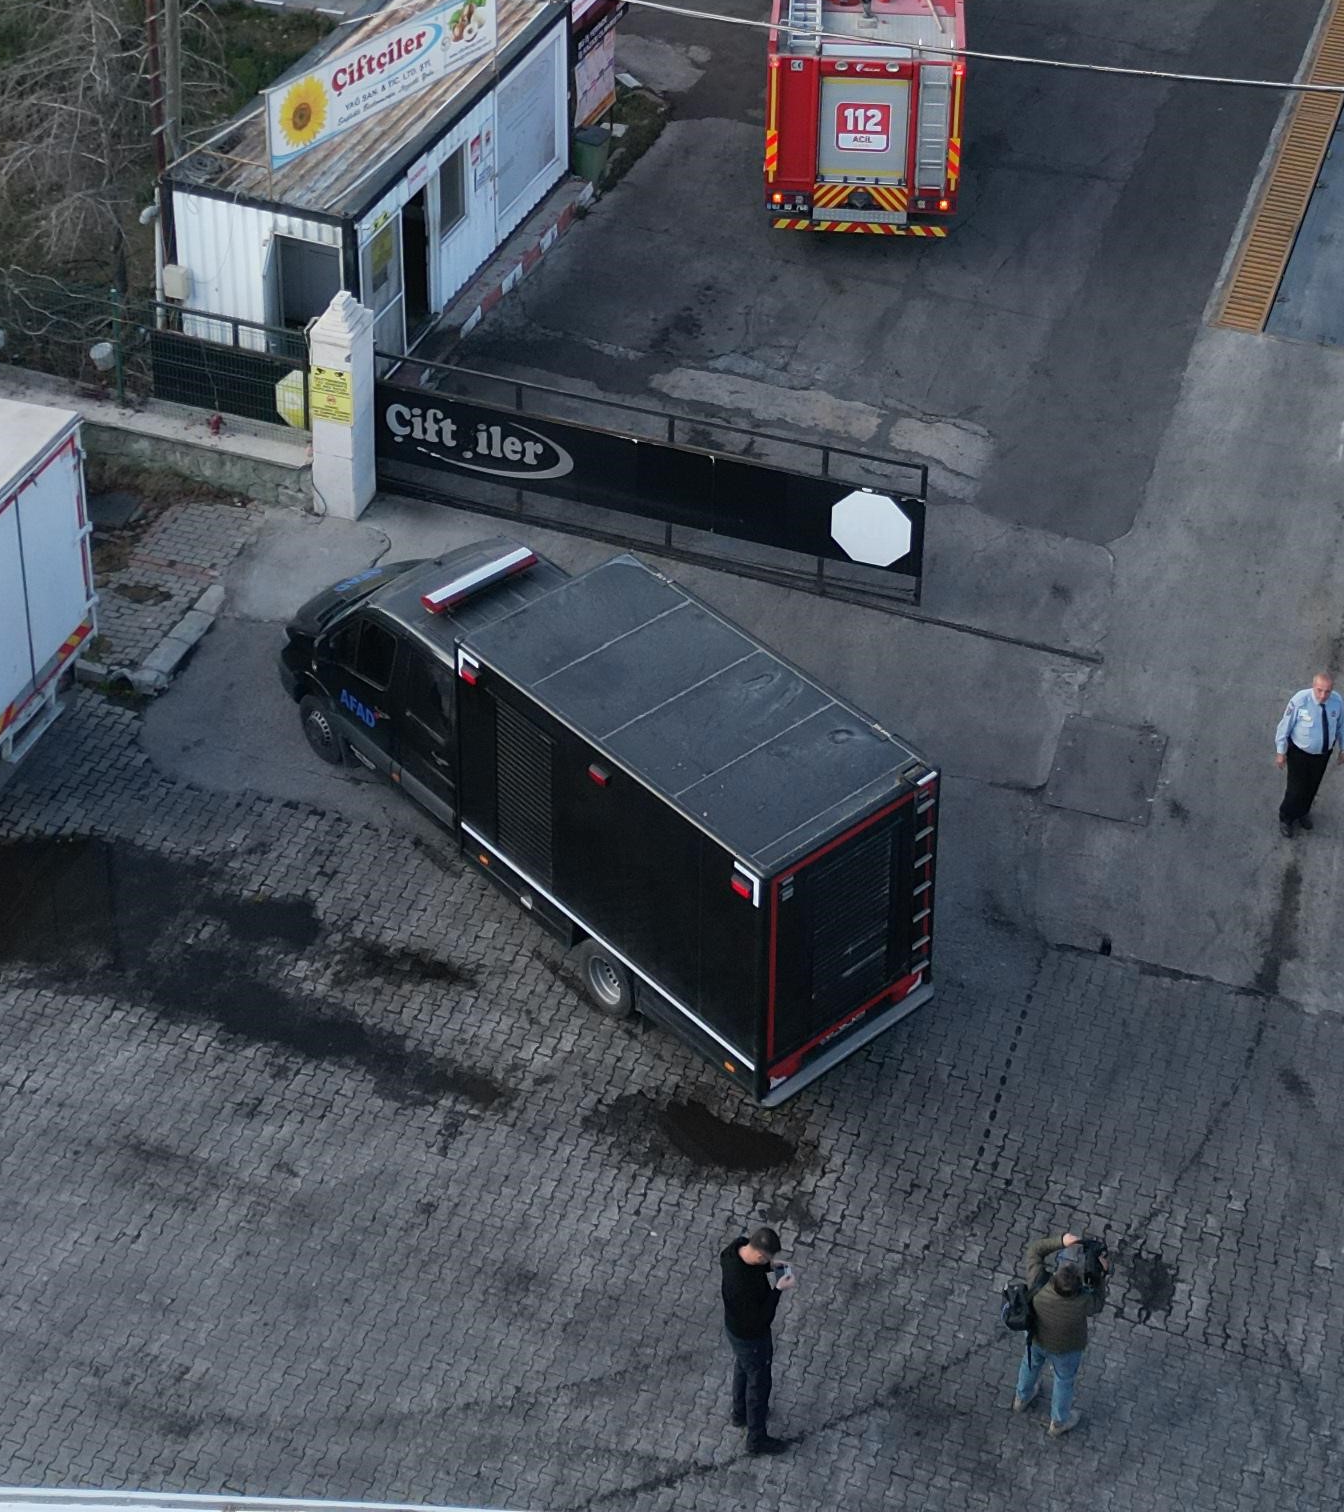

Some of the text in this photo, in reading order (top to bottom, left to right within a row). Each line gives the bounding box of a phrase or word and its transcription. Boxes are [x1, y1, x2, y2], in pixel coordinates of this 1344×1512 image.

[332, 31, 427, 97] Çiftçiler
[844, 108, 882, 131] 112
[385, 403, 544, 466] Çiftiler
[340, 689, 376, 728] AFAD
